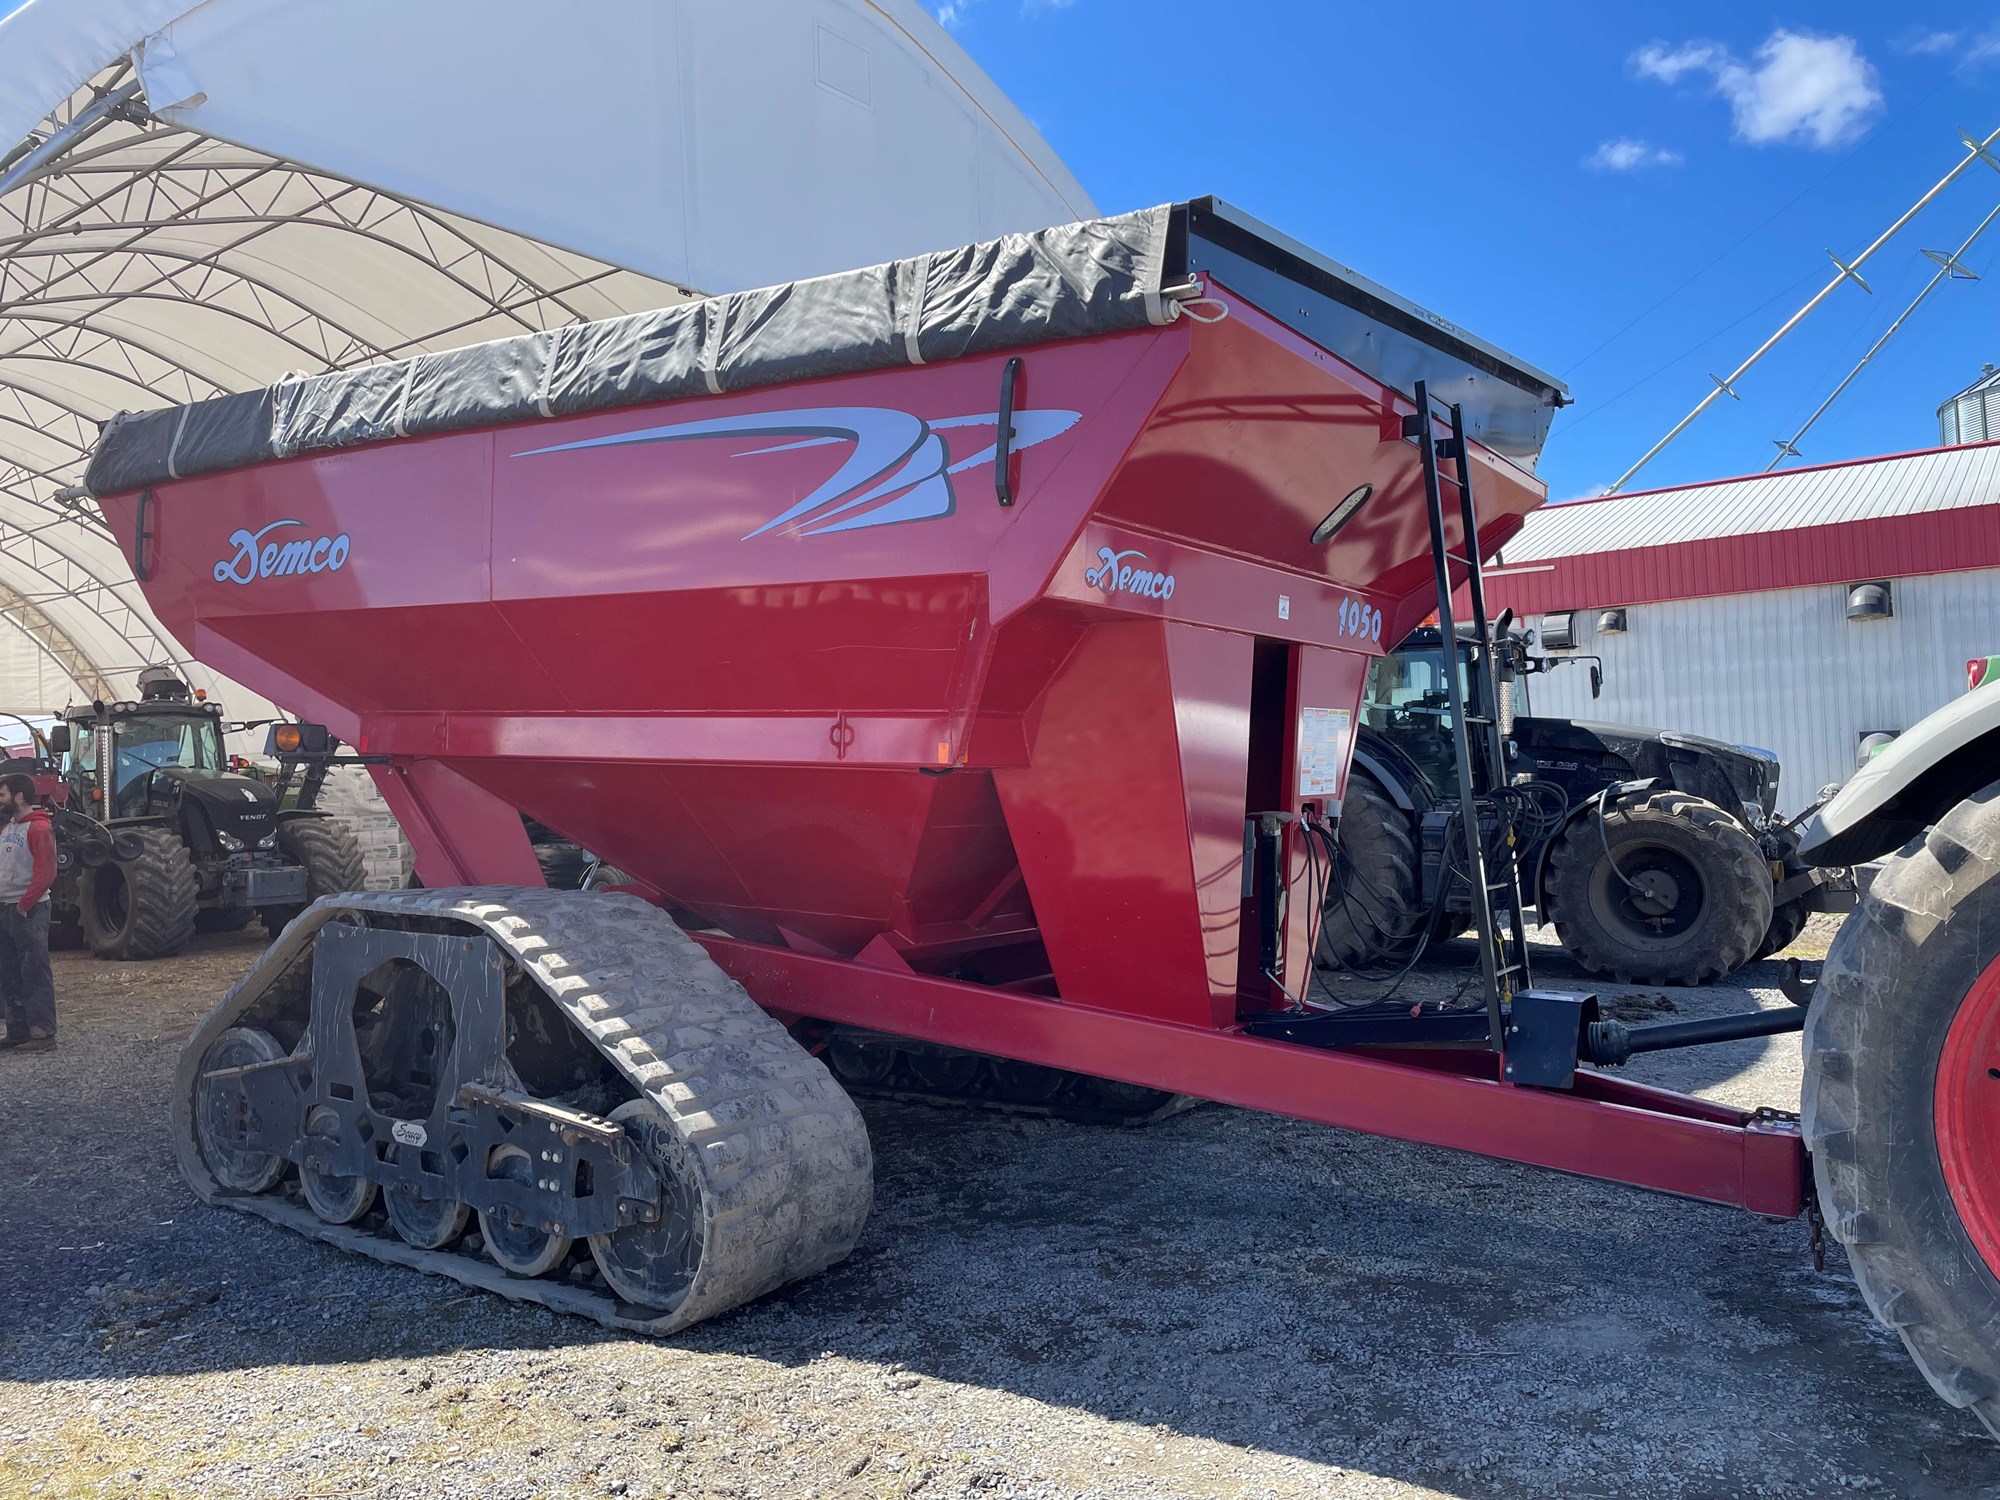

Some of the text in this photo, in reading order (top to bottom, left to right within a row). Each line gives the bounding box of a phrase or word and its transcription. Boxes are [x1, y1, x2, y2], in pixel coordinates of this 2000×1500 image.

[213, 518, 350, 585] Demco
[1085, 546, 1175, 600] Demco
[1338, 595, 1382, 644] 1050
[239, 813, 267, 821] FENDT
